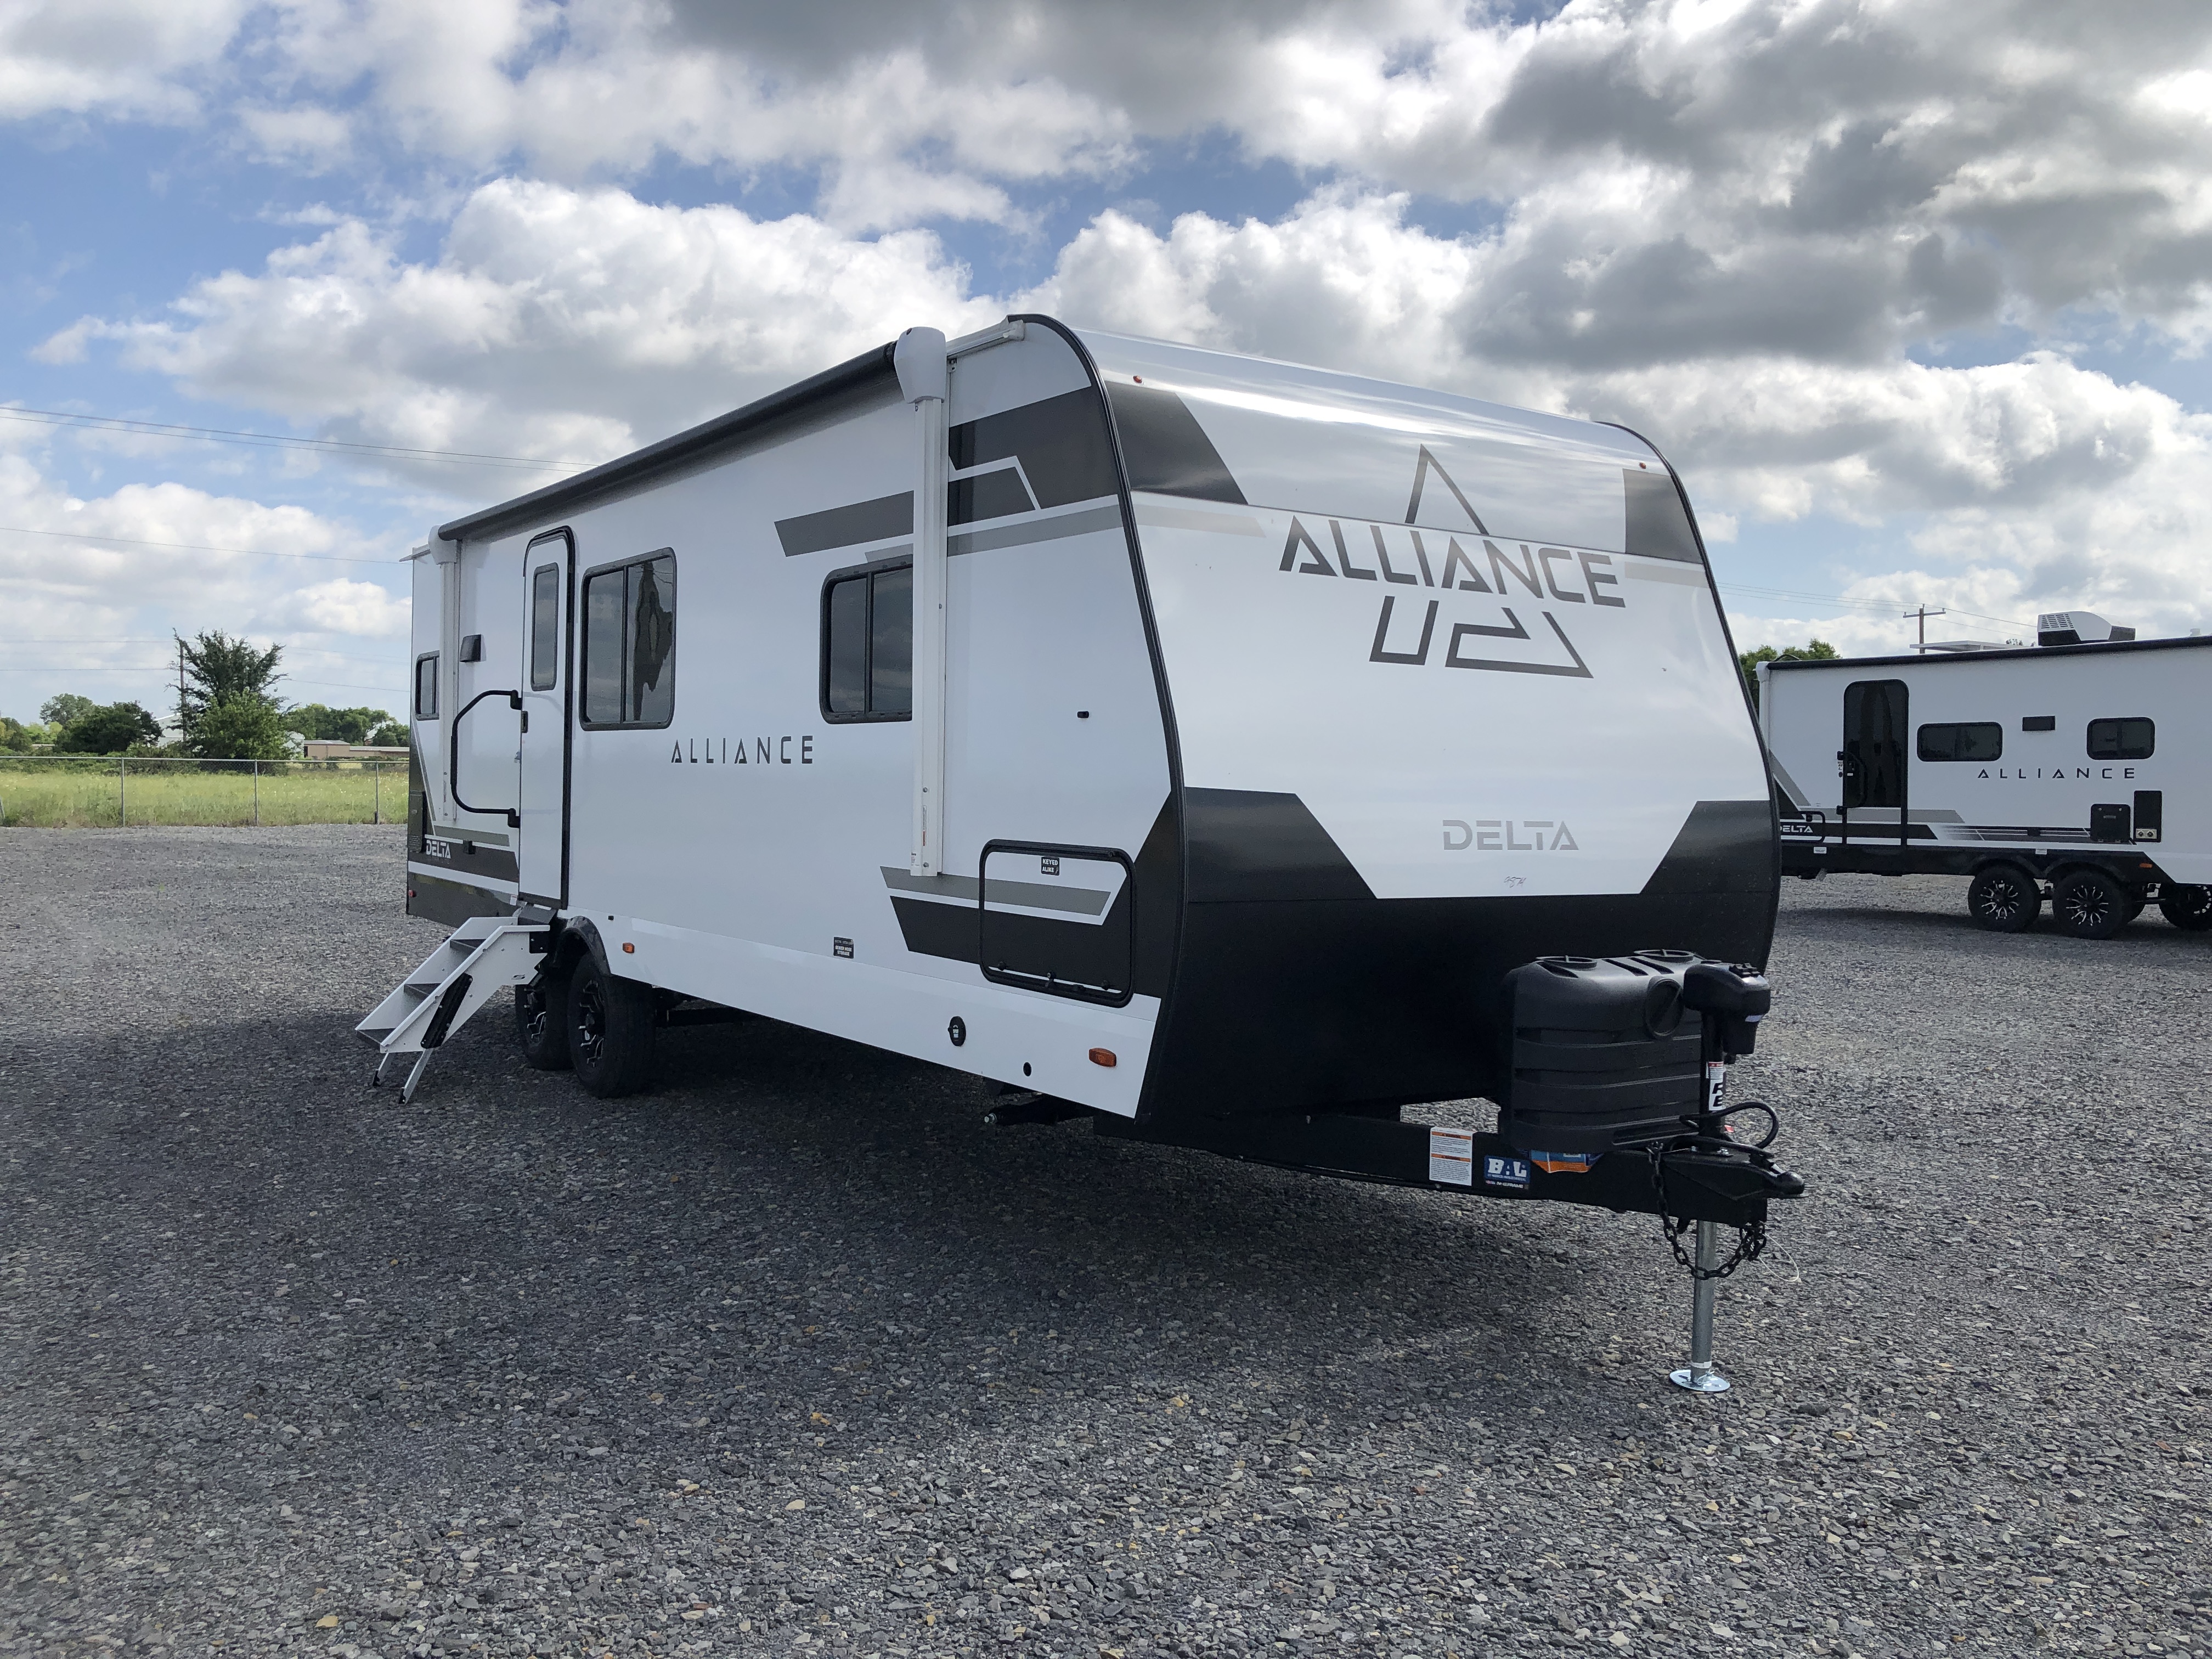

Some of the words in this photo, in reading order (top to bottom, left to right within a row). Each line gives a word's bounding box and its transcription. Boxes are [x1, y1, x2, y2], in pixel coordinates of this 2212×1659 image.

[1279, 515, 1626, 608] ALLIANCE
[671, 735, 813, 764] ALLIANCE
[1977, 768, 2136, 779] ALLIANCE
[1443, 820, 1579, 850] DELTA
[426, 839, 452, 859] DELTA
[1487, 1158, 1527, 1177] BAL
